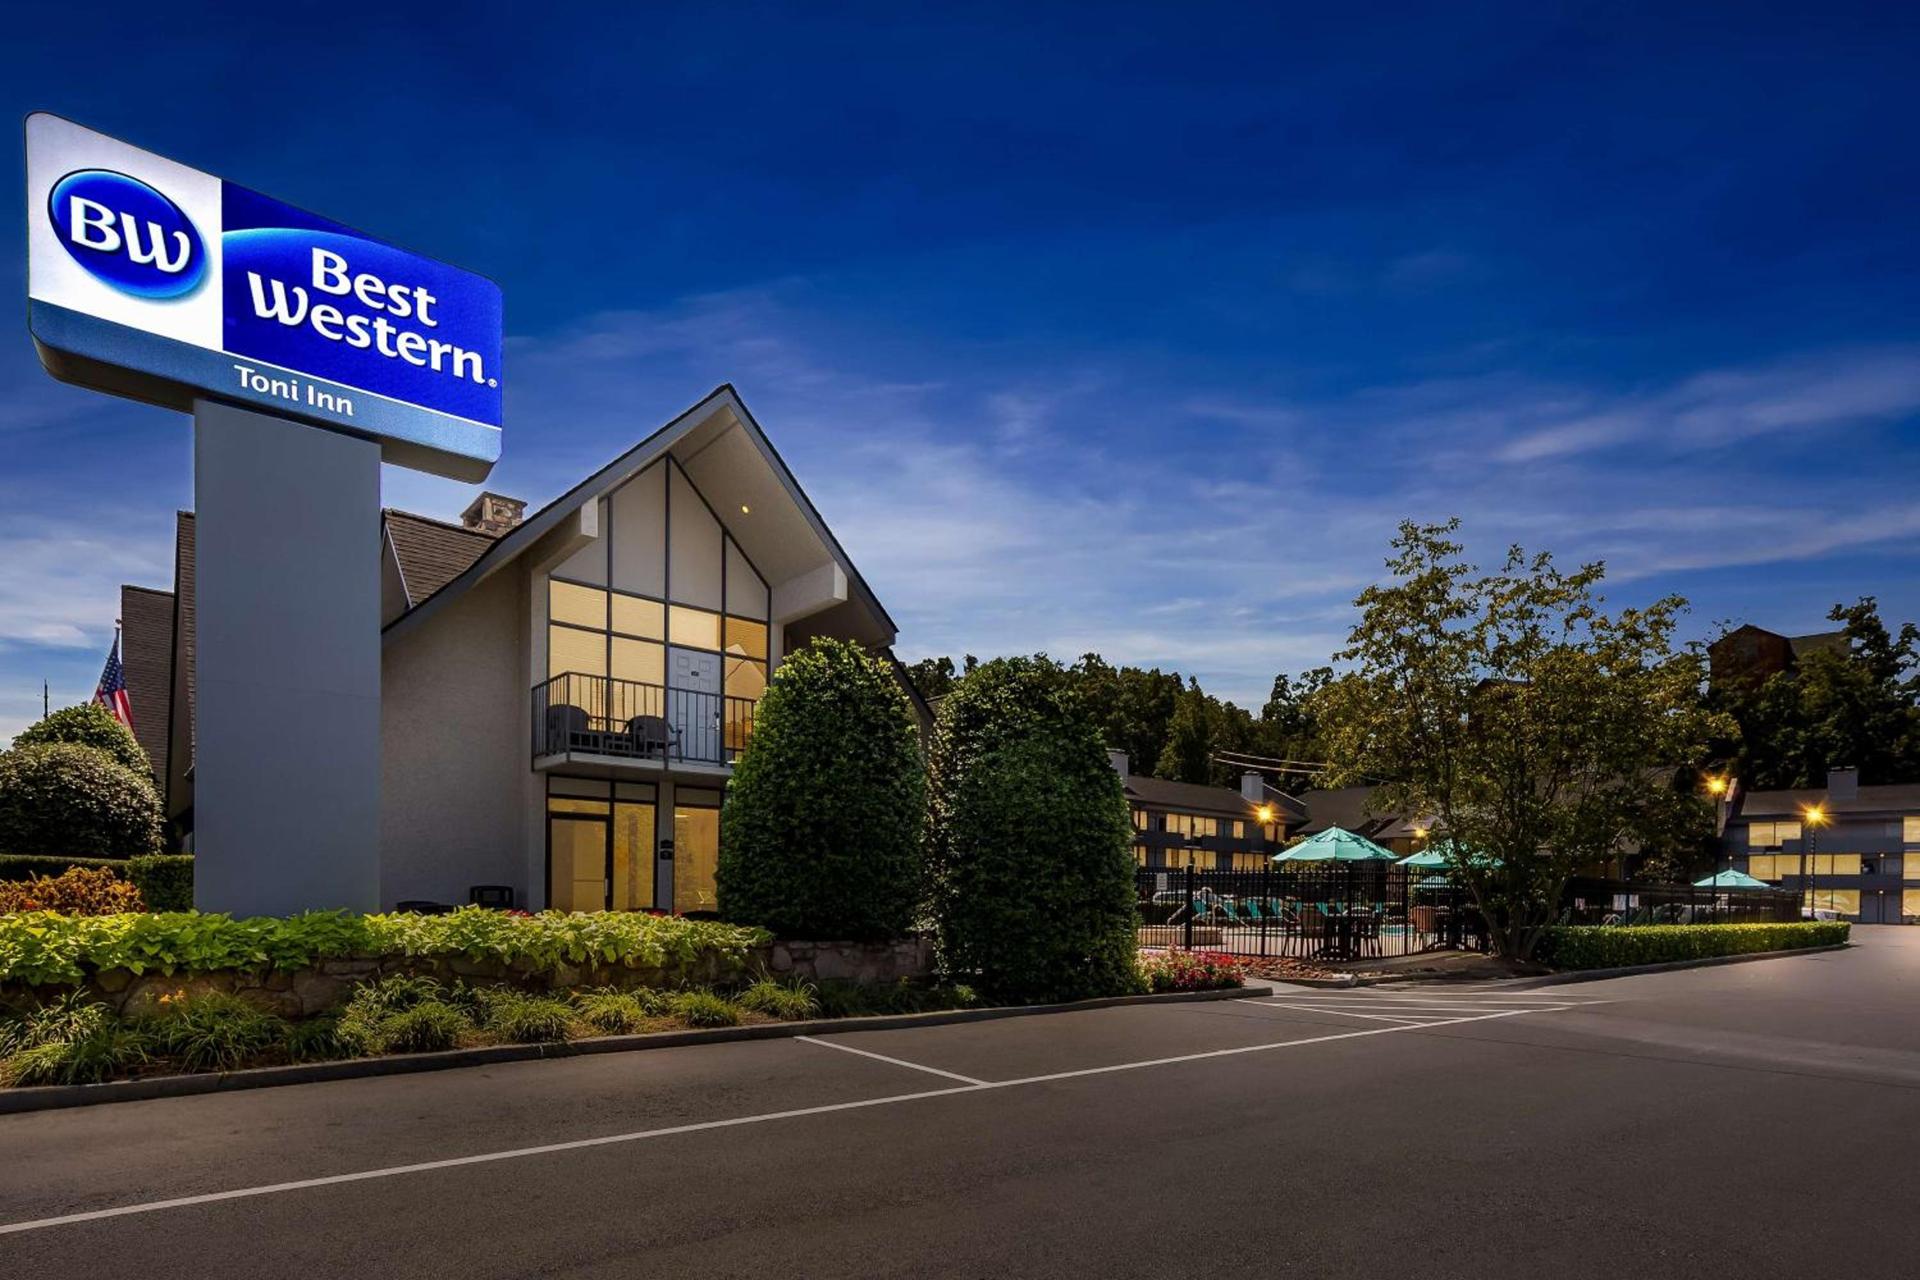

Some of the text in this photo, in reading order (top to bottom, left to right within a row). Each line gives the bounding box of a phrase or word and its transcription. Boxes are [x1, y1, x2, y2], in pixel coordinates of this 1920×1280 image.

[71, 196, 190, 273] BW
[312, 247, 438, 327] Best
[247, 271, 486, 384] Western
[234, 364, 354, 416] Toni Inn
